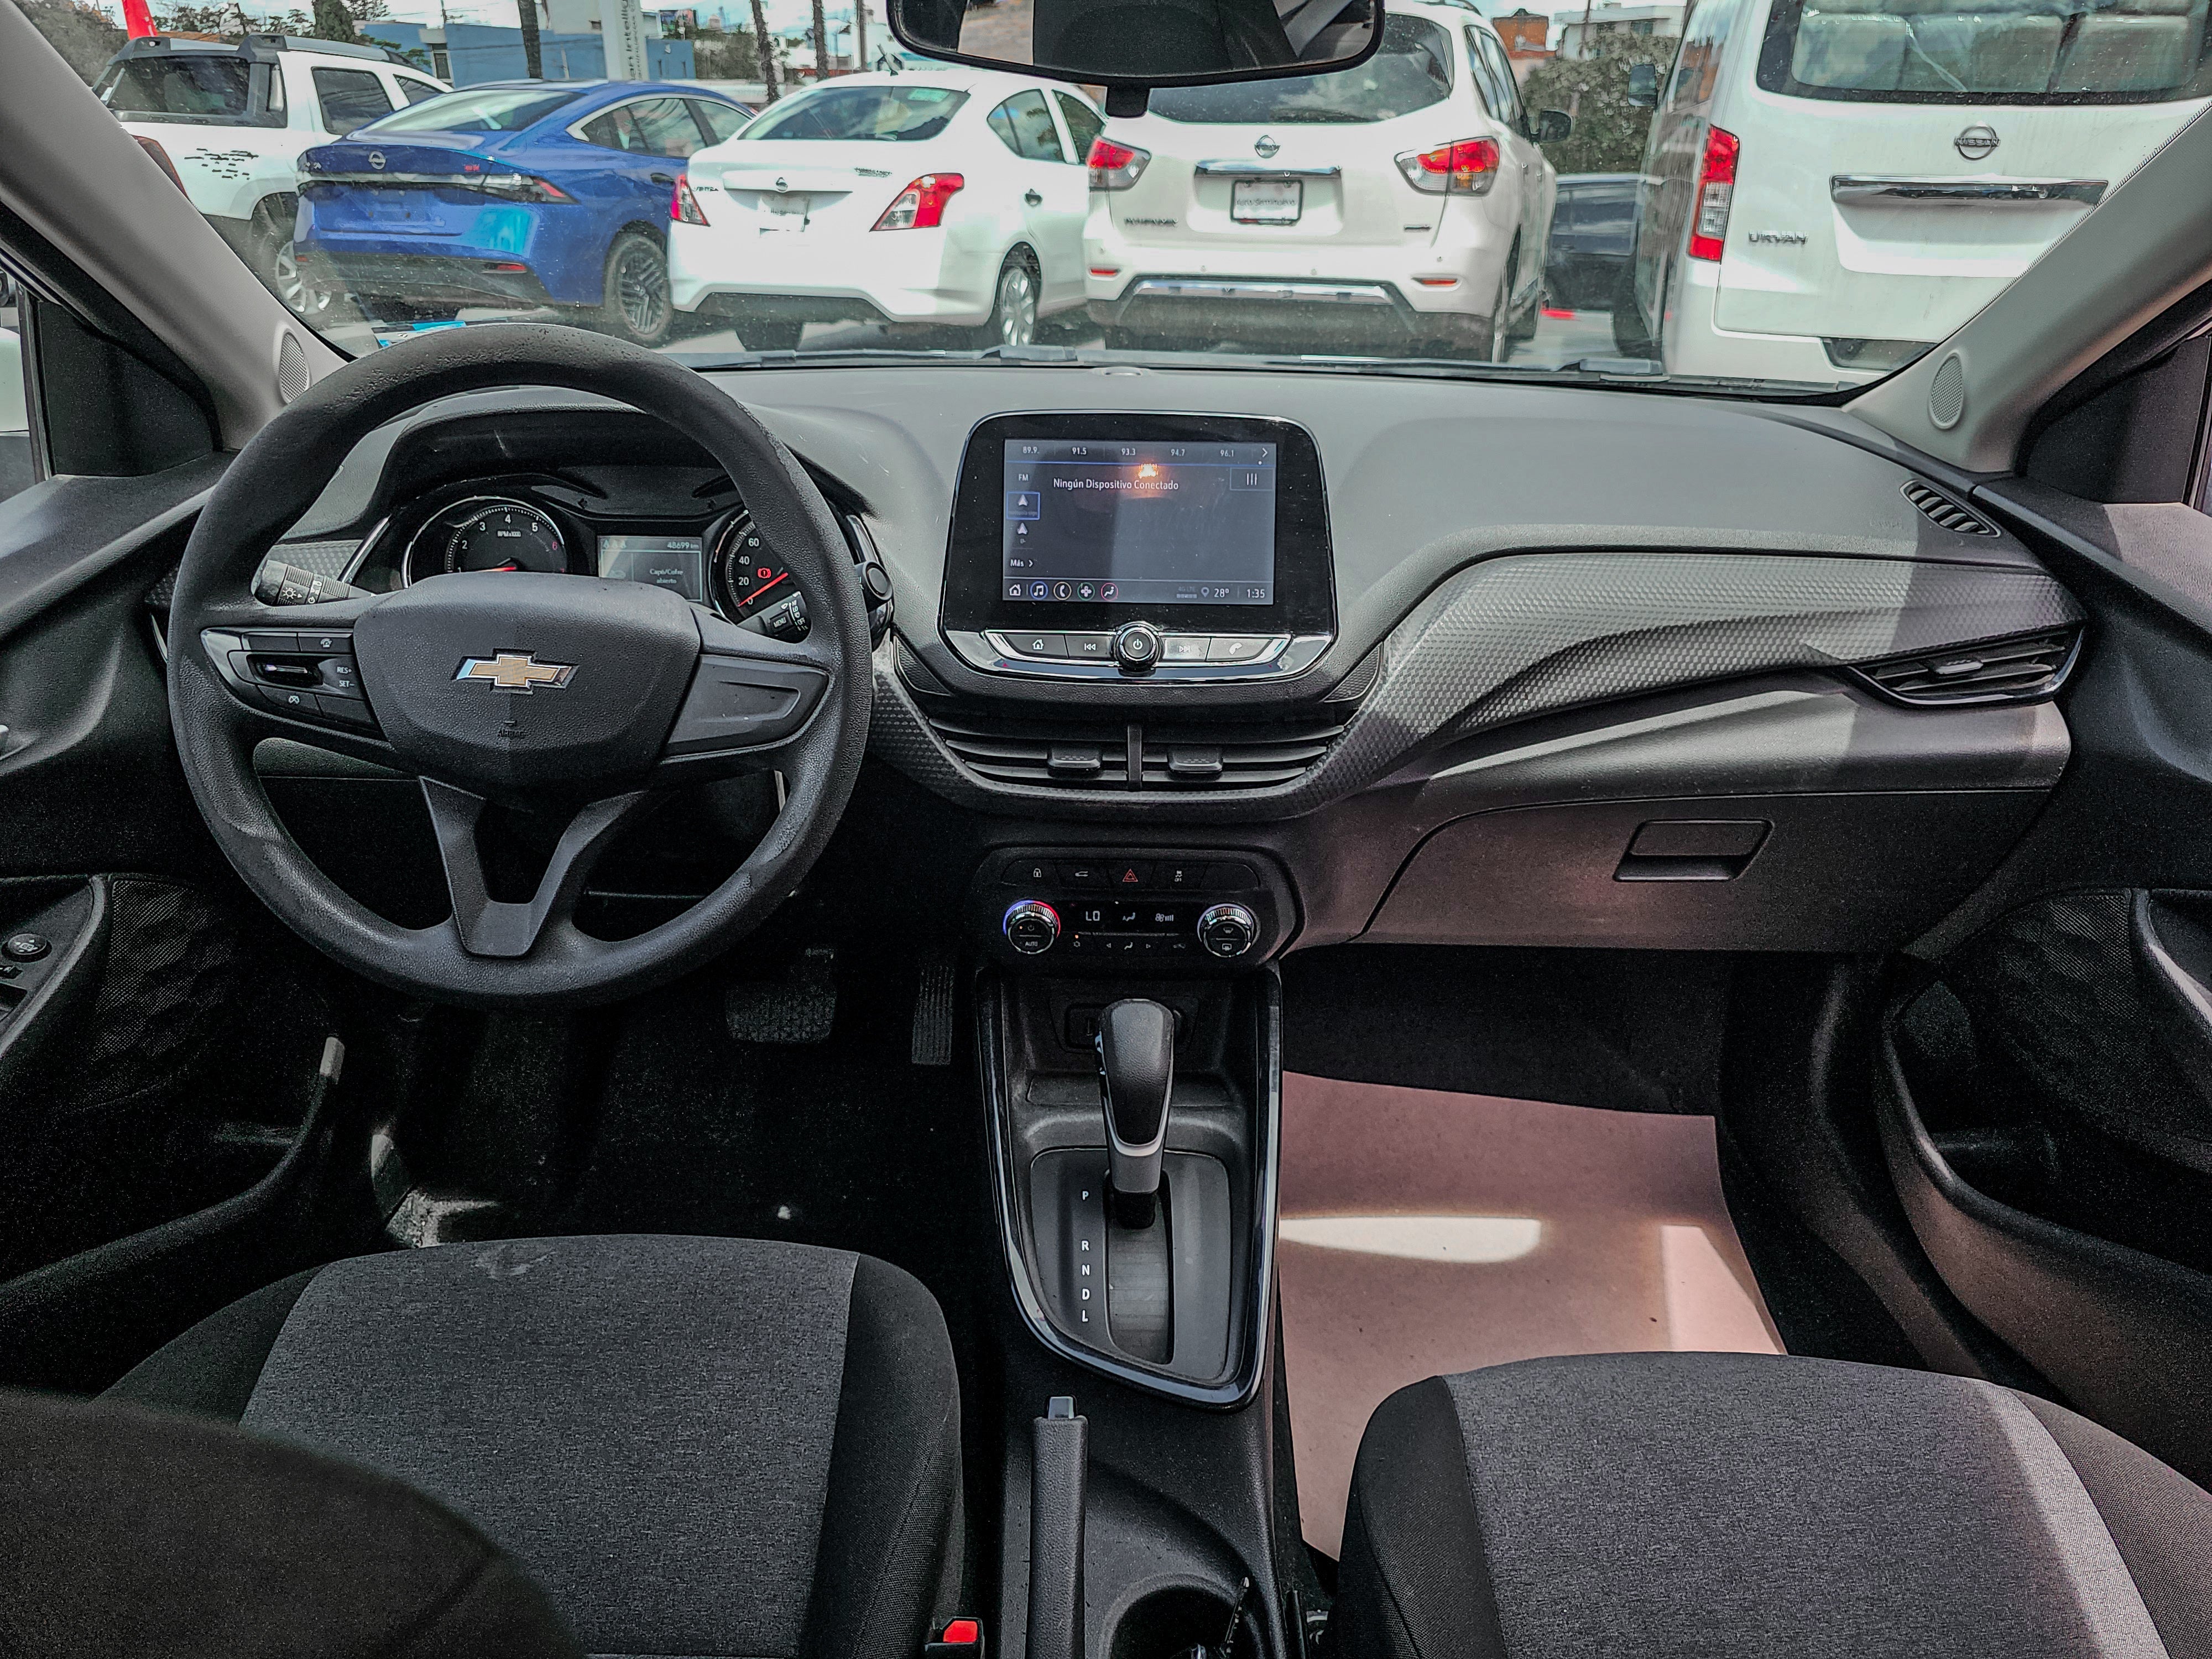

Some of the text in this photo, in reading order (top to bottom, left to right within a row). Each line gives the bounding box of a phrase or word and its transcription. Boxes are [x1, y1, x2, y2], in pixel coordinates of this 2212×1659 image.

[1954, 137, 2000, 147] NISSAN
[1053, 478, 1178, 491] Ningún Dispositivo Conectado
[505, 514, 511, 523] 4
[479, 522, 486, 531] 3
[532, 523, 538, 531] 5
[462, 540, 467, 549] 2
[552, 541, 557, 550] 6
[748, 538, 759, 546] 60
[739, 556, 749, 565] 40
[738, 577, 749, 586] 20
[1247, 589, 1265, 598] 1:35
[1086, 910, 1100, 921] LO
[1082, 1191, 1089, 1201] P
[1081, 1240, 1089, 1251] R
[1082, 1264, 1090, 1276] N
[1082, 1288, 1090, 1300] D
[1082, 1310, 1088, 1322] L
